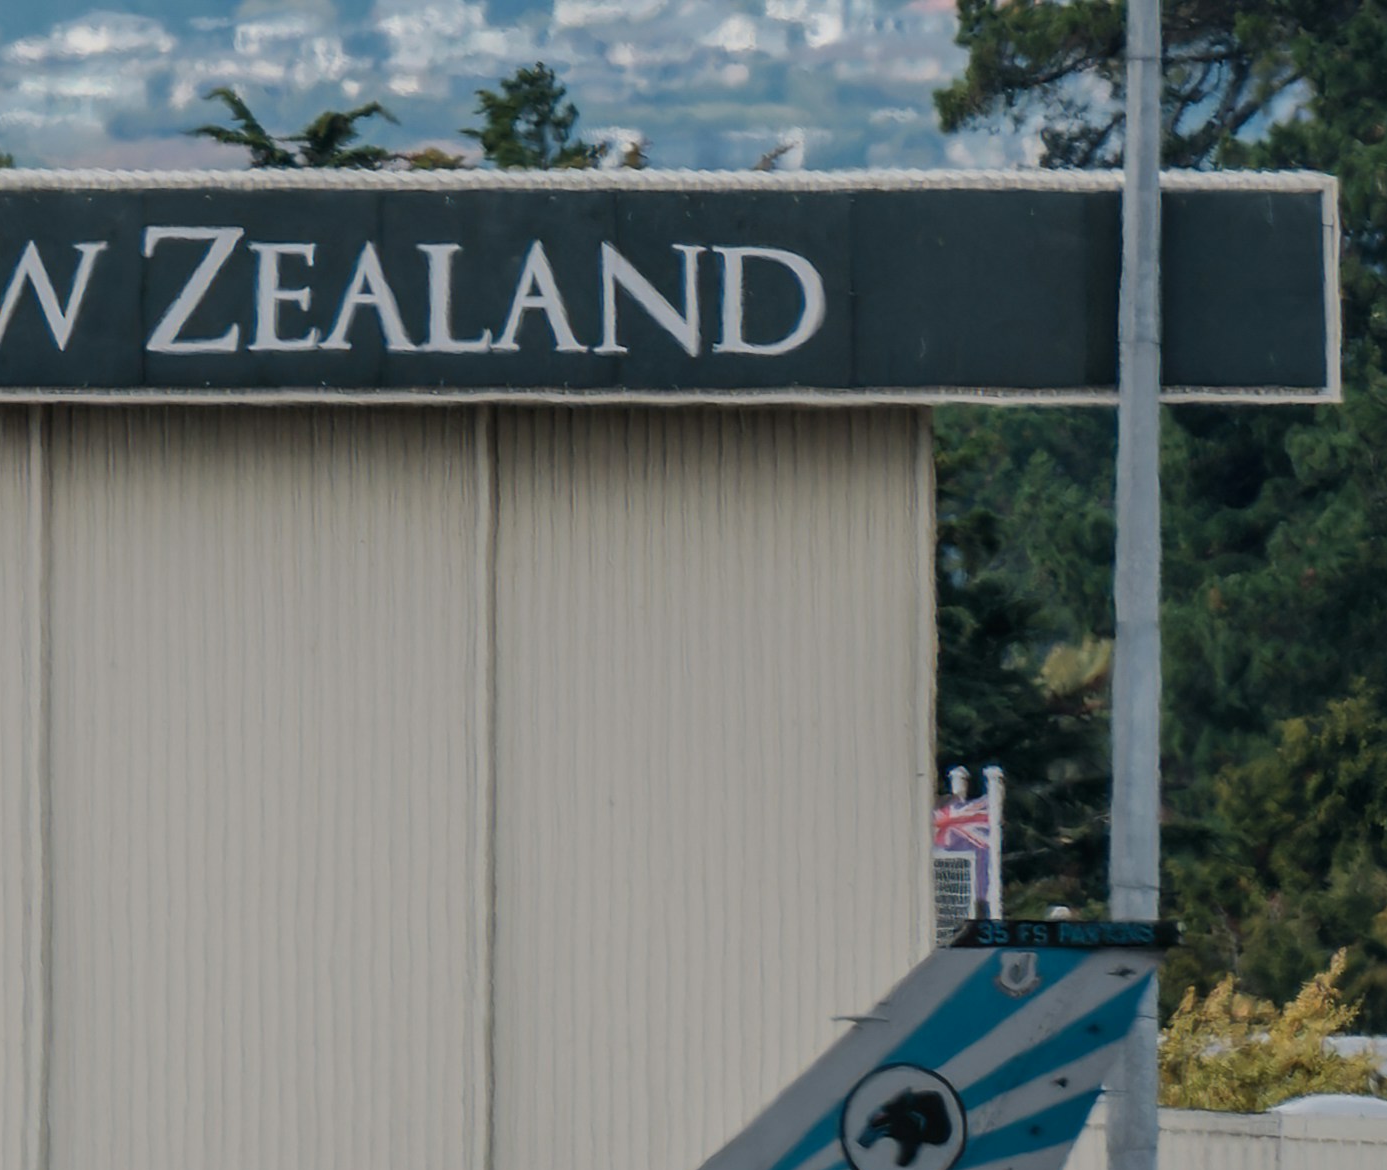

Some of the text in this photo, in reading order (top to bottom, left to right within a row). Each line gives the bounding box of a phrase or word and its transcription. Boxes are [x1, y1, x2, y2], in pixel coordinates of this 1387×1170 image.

[142, 225, 826, 357] ZEALAND
[977, 922, 1009, 945] 35
[1018, 924, 1048, 945] FS
